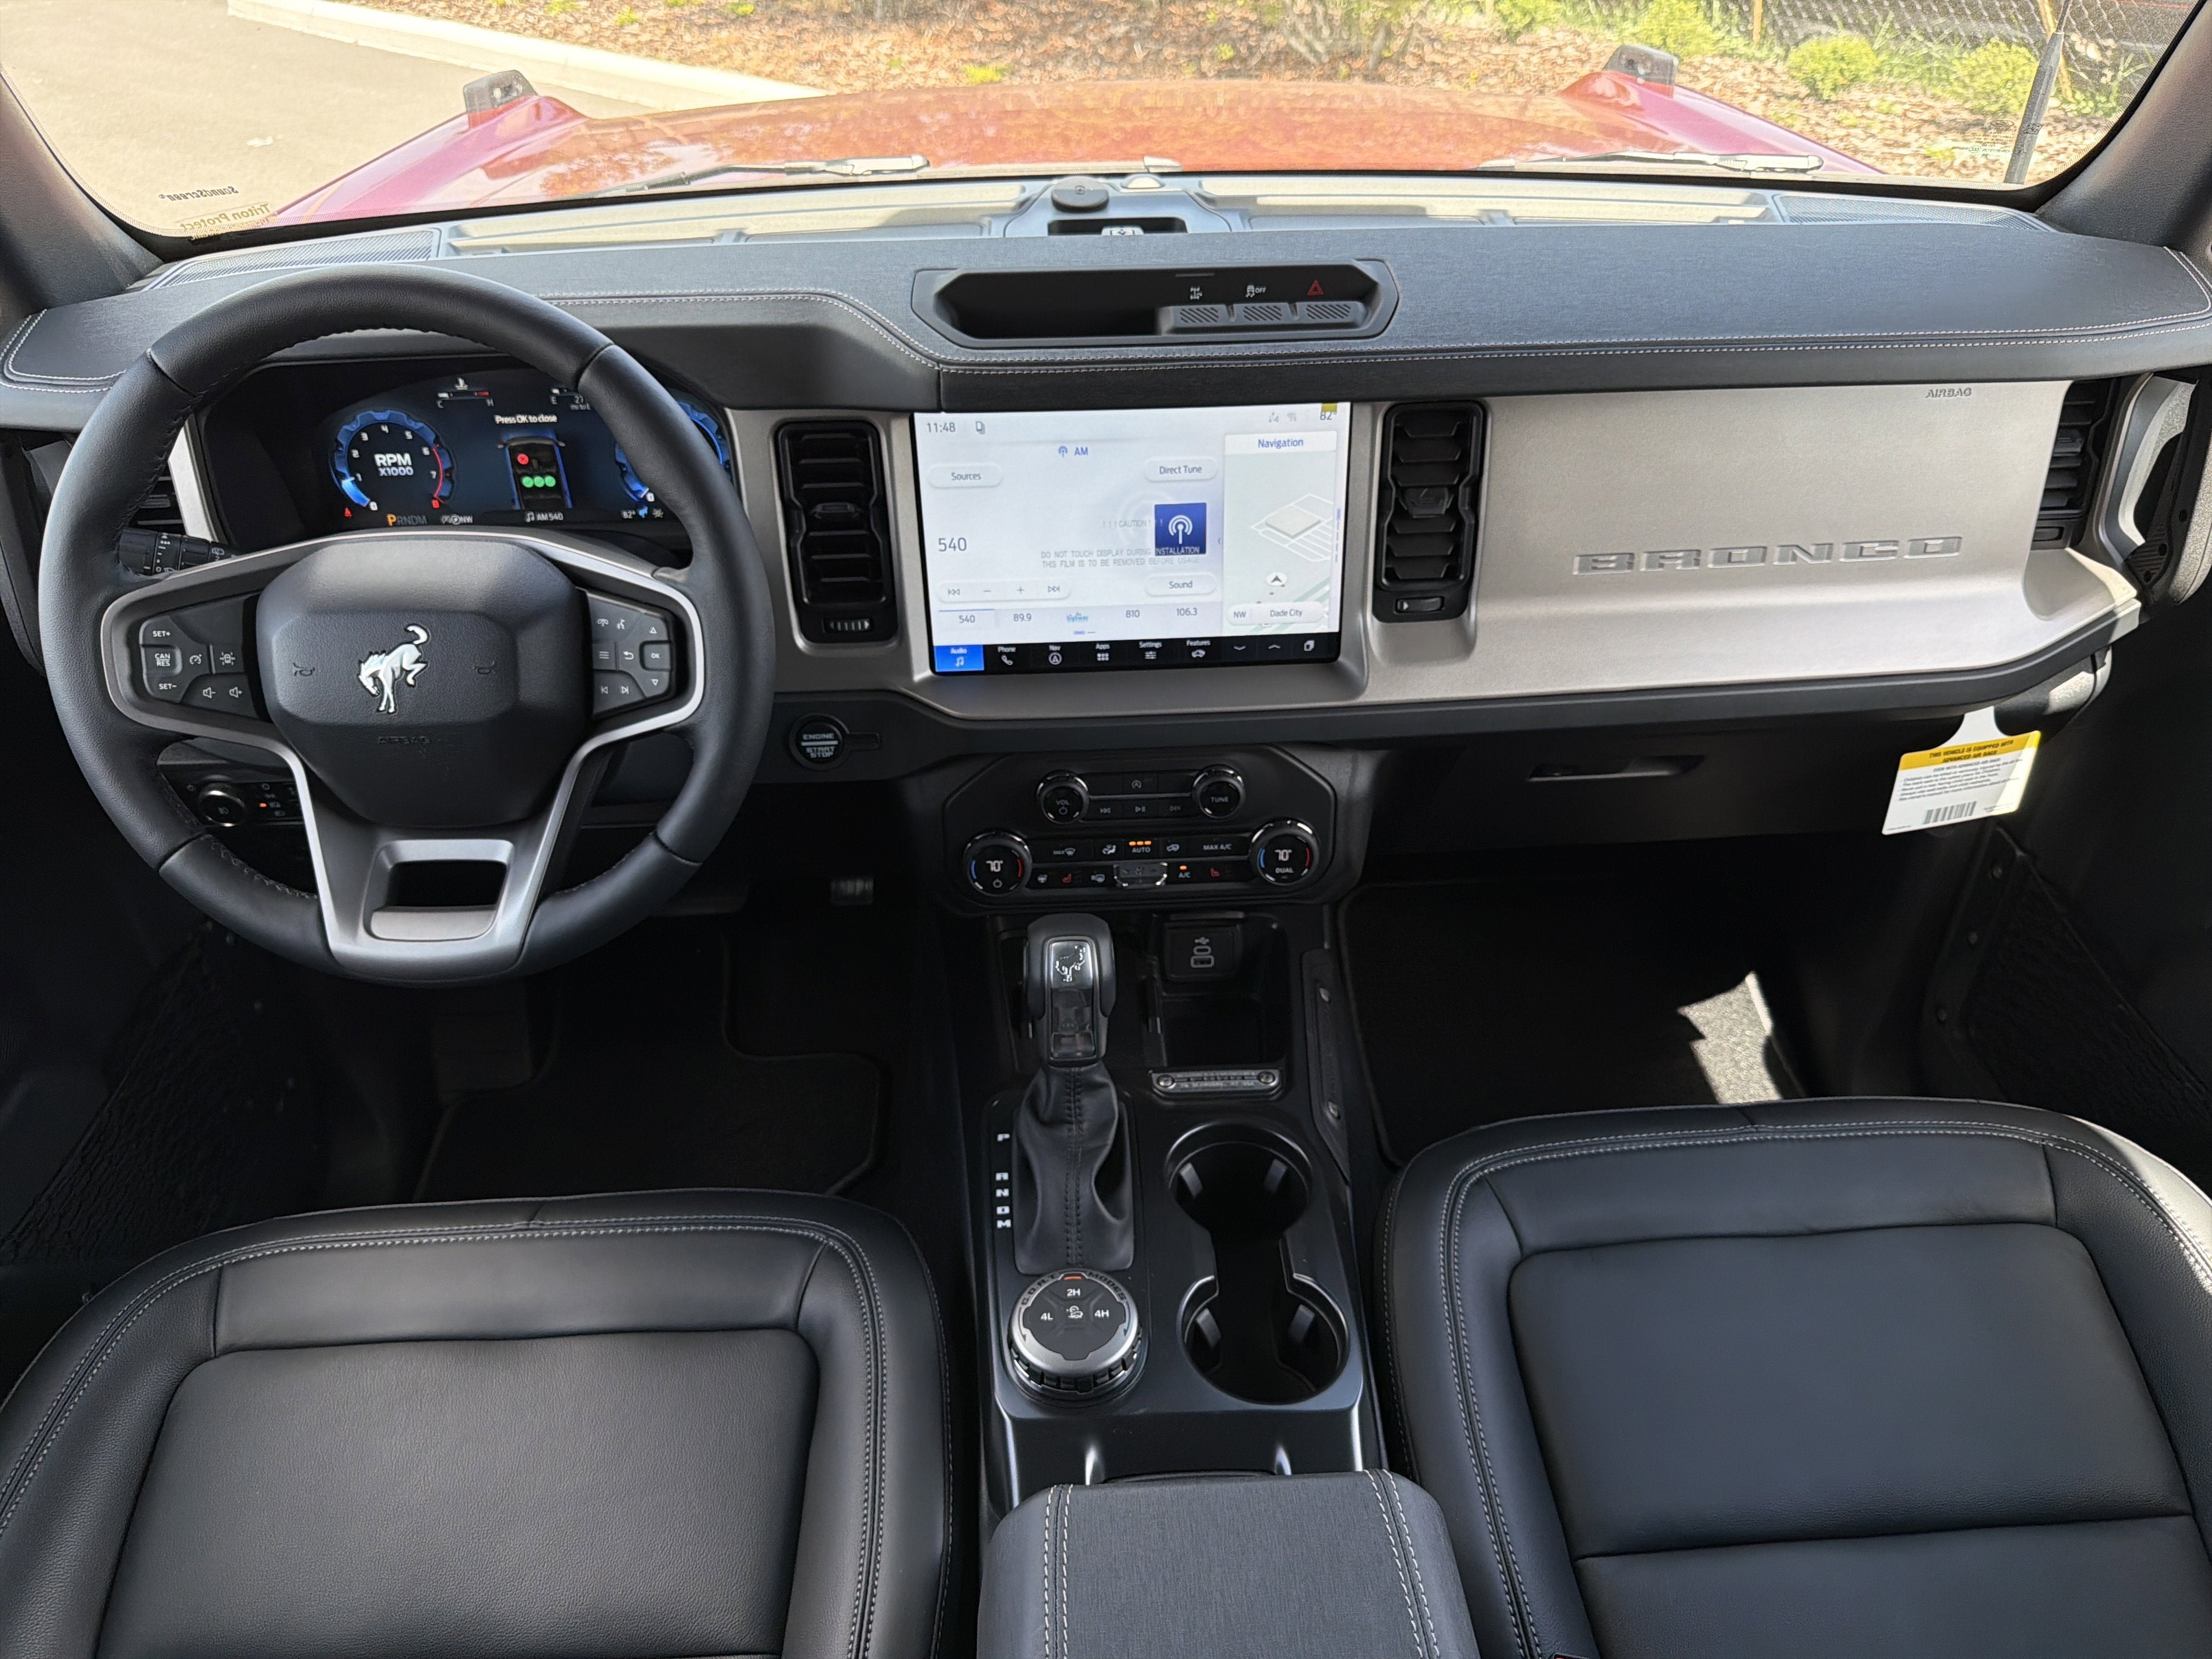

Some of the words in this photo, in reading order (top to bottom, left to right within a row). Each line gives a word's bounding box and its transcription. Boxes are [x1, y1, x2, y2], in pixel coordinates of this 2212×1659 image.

[1255, 286, 1266, 295] OFF
[1926, 387, 1972, 399] AIRBAG
[487, 398, 494, 407] H
[550, 396, 557, 405] E
[495, 414, 516, 424] Press
[516, 414, 527, 424] OK
[529, 414, 538, 423] to
[538, 413, 557, 423] close
[380, 425, 389, 433] 4
[927, 422, 956, 433] 11:48
[404, 431, 413, 439] 5
[1258, 439, 1304, 449] Navigation
[1074, 447, 1088, 456] AM
[374, 453, 412, 466] RPM
[379, 466, 414, 476] X1000
[1159, 465, 1181, 475] Direct
[1183, 465, 1202, 473] Tune
[951, 472, 981, 481] Sources
[369, 501, 378, 511] 0
[537, 512, 549, 521] AM
[550, 512, 563, 521] 540
[938, 538, 967, 552] 540
[1097, 549, 1124, 557] DISPLAY
[1154, 546, 1200, 555] NSTALLATION
[1573, 536, 1962, 575] BRONCO
[1113, 558, 1145, 566] REMOVED
[1169, 580, 1193, 589] Sound
[1126, 610, 1140, 618] 810
[1176, 608, 1198, 617] 106.3
[1289, 609, 1302, 618] City
[959, 615, 975, 624] 540
[1013, 613, 1031, 622] 89.9
[997, 1133, 1010, 1142] P
[996, 1188, 1009, 1198] N
[997, 1219, 1012, 1228] M
[1088, 1271, 1127, 1300] MODES
[1066, 1288, 1081, 1297] 2H
[1040, 1312, 1054, 1321] 4L
[1094, 1308, 1109, 1318] 4H
